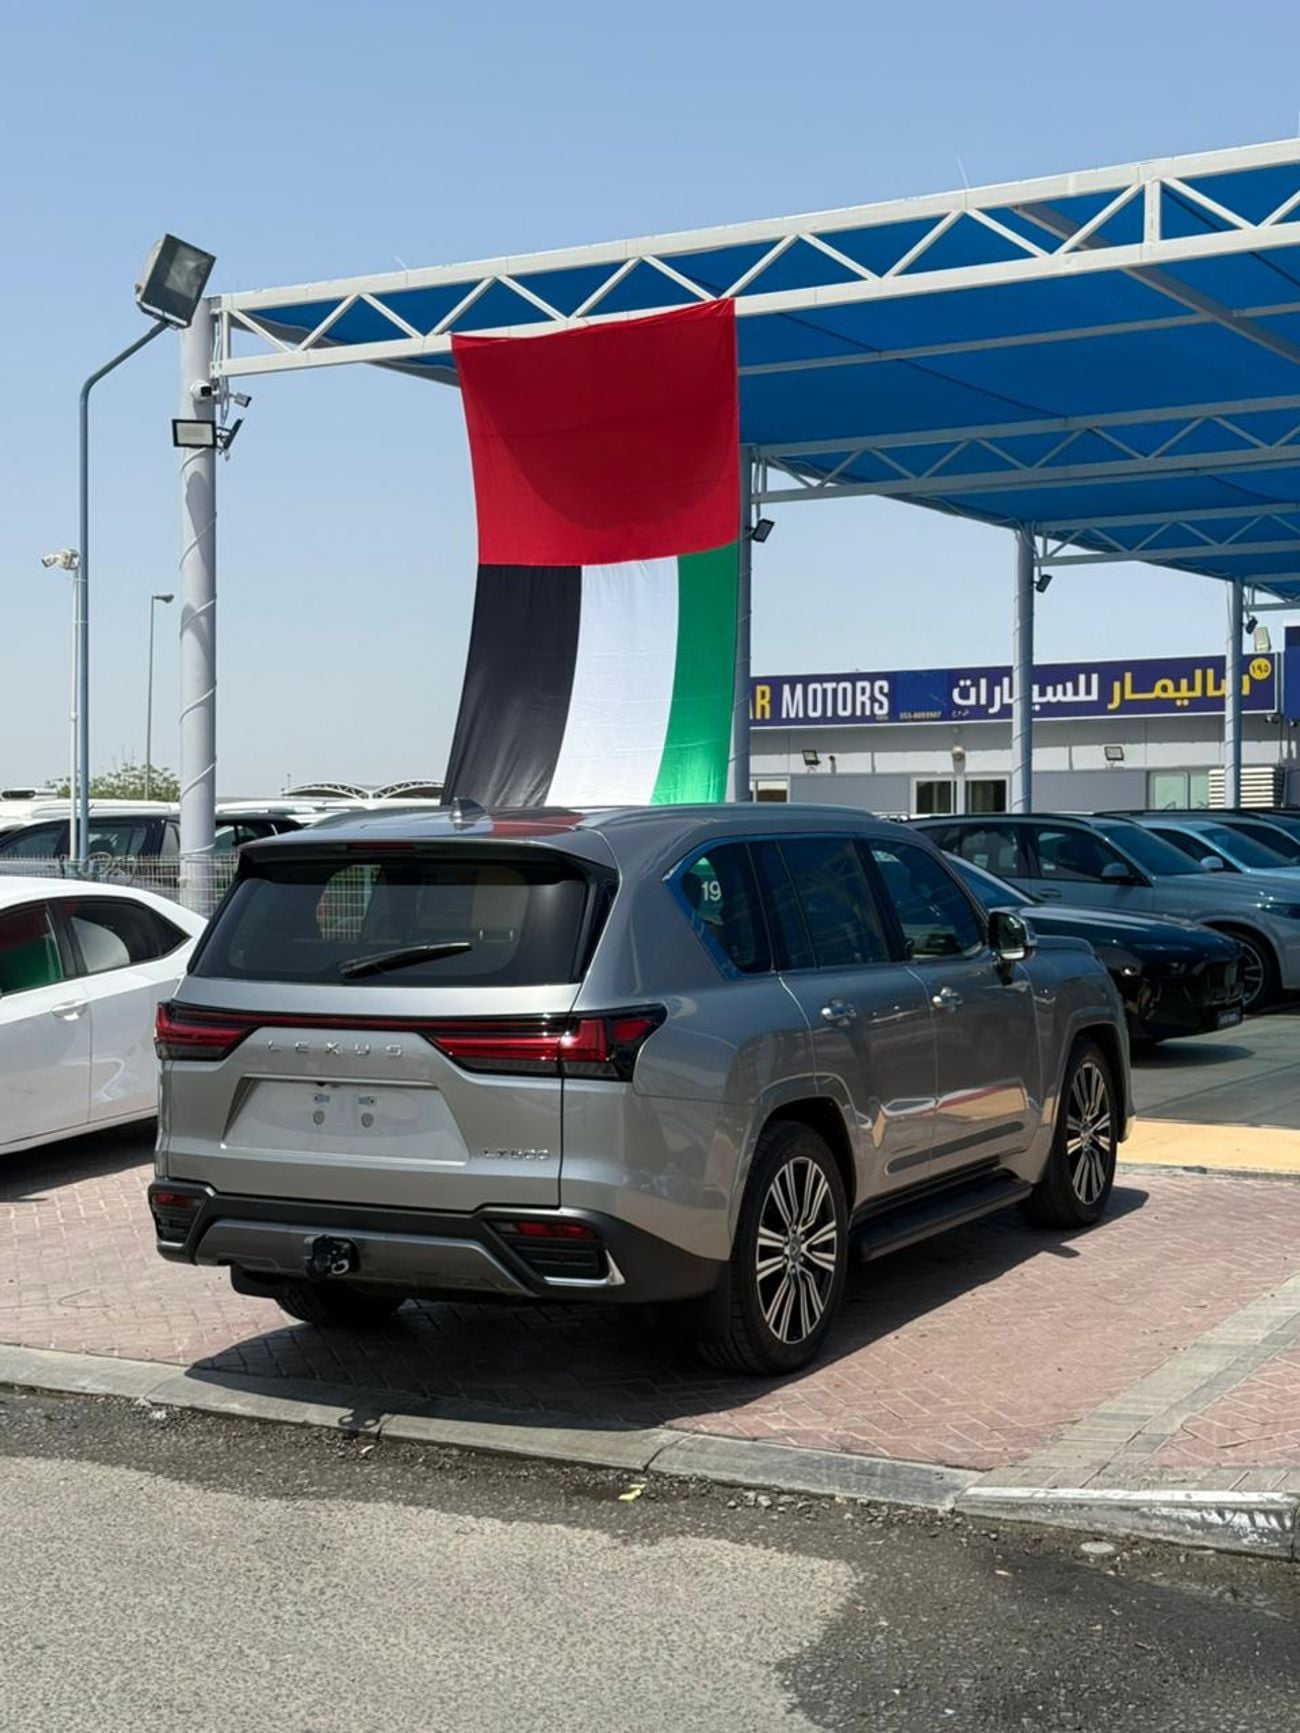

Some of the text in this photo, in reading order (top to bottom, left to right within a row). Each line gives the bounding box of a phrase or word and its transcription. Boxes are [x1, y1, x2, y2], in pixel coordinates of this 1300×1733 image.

[749, 680, 889, 720] R MOTORS
[701, 880, 722, 901] 19
[266, 1039, 402, 1056] LEXUS
